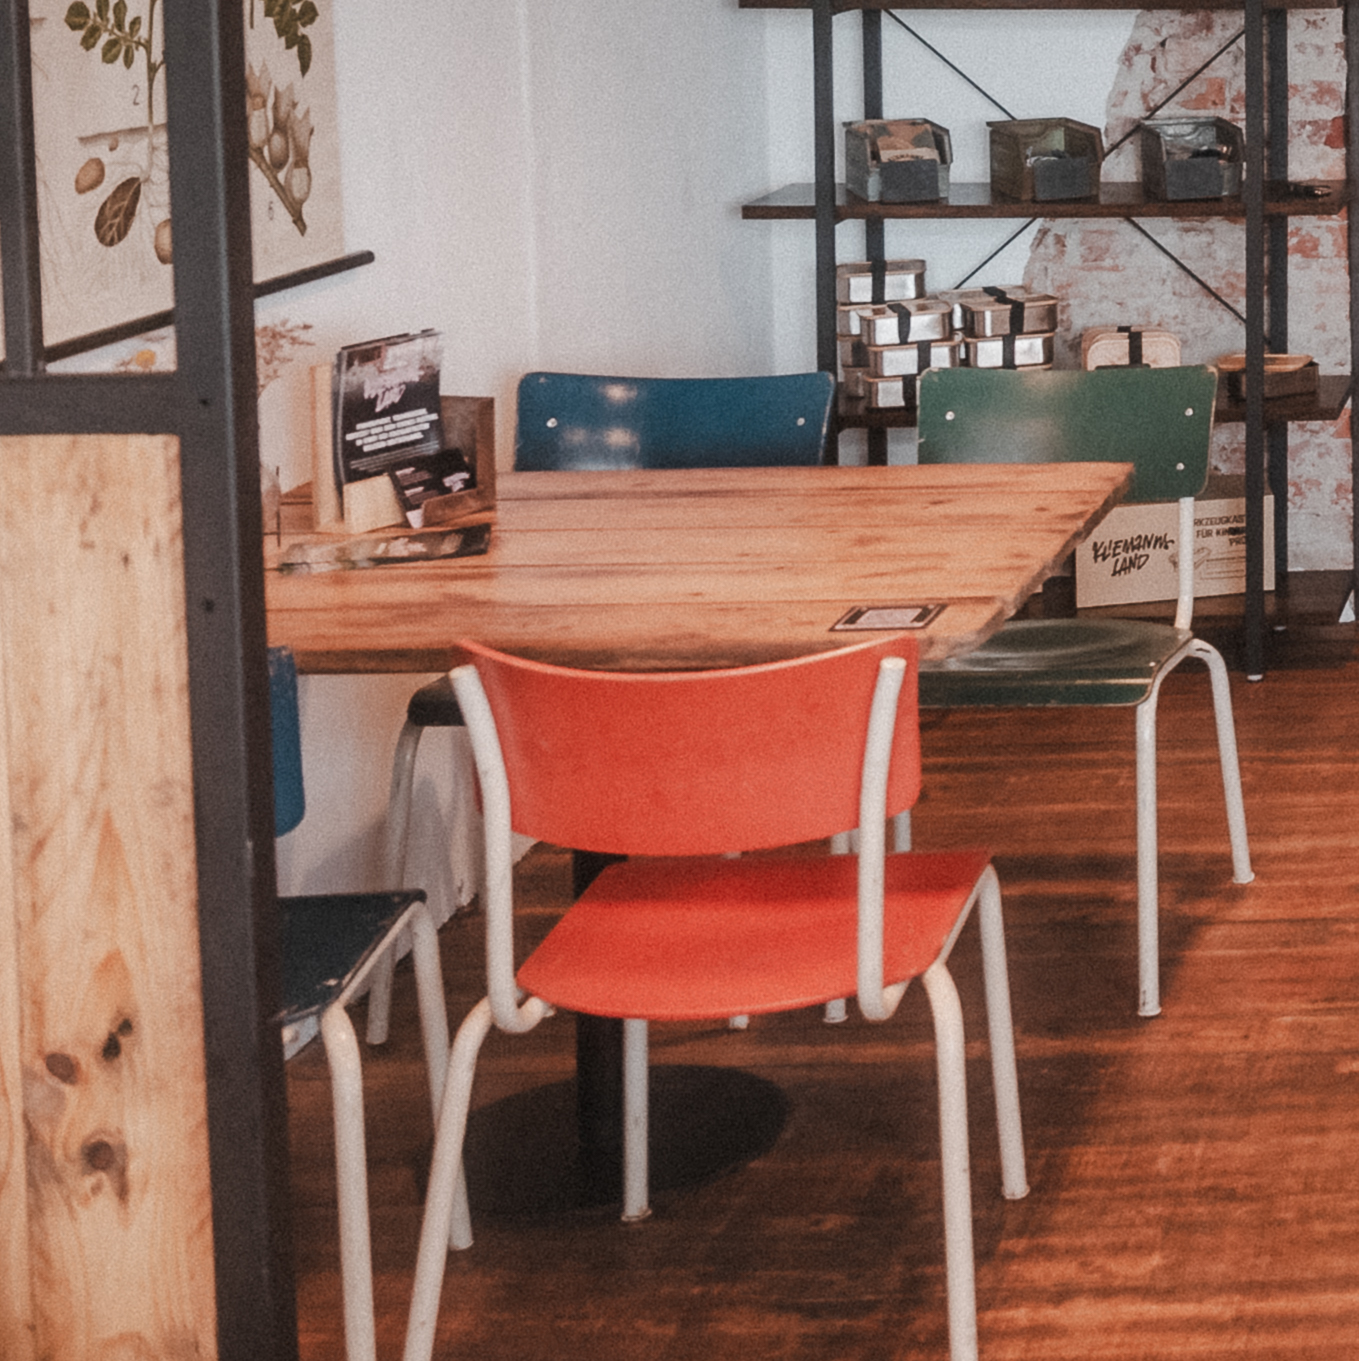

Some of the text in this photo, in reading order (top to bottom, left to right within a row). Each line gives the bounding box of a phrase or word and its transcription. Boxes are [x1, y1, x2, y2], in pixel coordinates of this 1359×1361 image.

[131, 83, 140, 106] 2
[1092, 533, 1175, 564] KLIEMANNS
[1111, 554, 1150, 577] LAND
